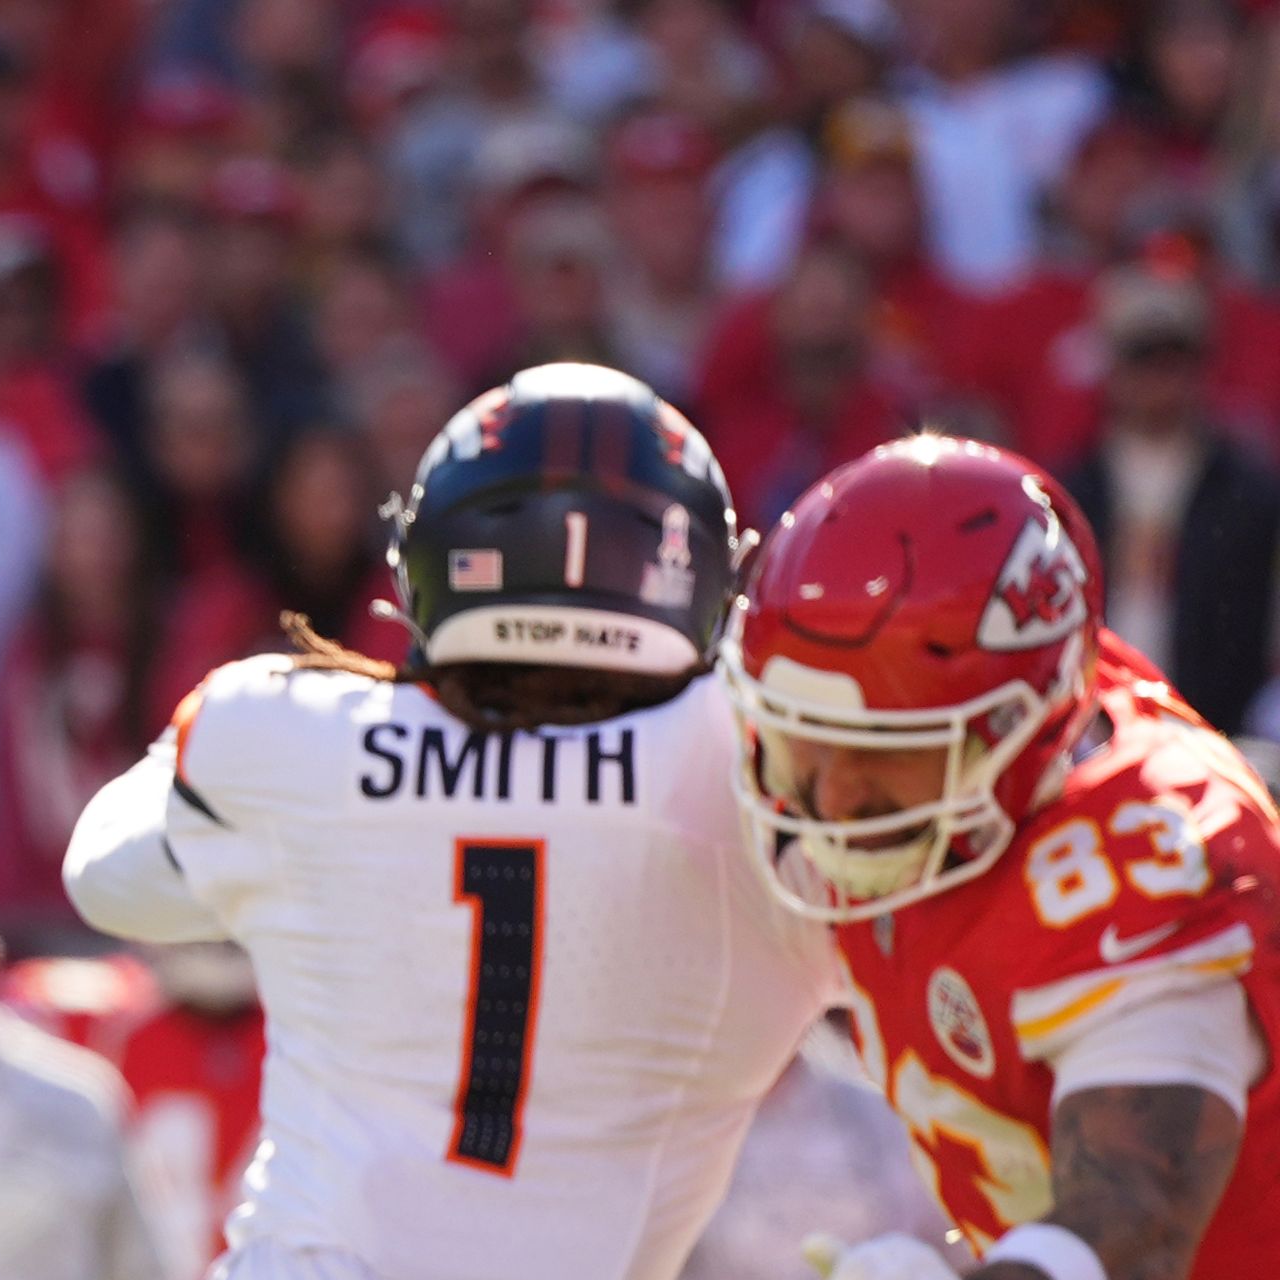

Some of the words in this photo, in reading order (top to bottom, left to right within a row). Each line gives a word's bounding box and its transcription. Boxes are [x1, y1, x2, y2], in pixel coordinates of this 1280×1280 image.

[564, 511, 588, 589] 1
[495, 617, 566, 643] STOP
[574, 624, 640, 652] HATE
[360, 724, 635, 803] SMITH
[1026, 799, 1213, 930] 83
[445, 838, 545, 1179] 1
